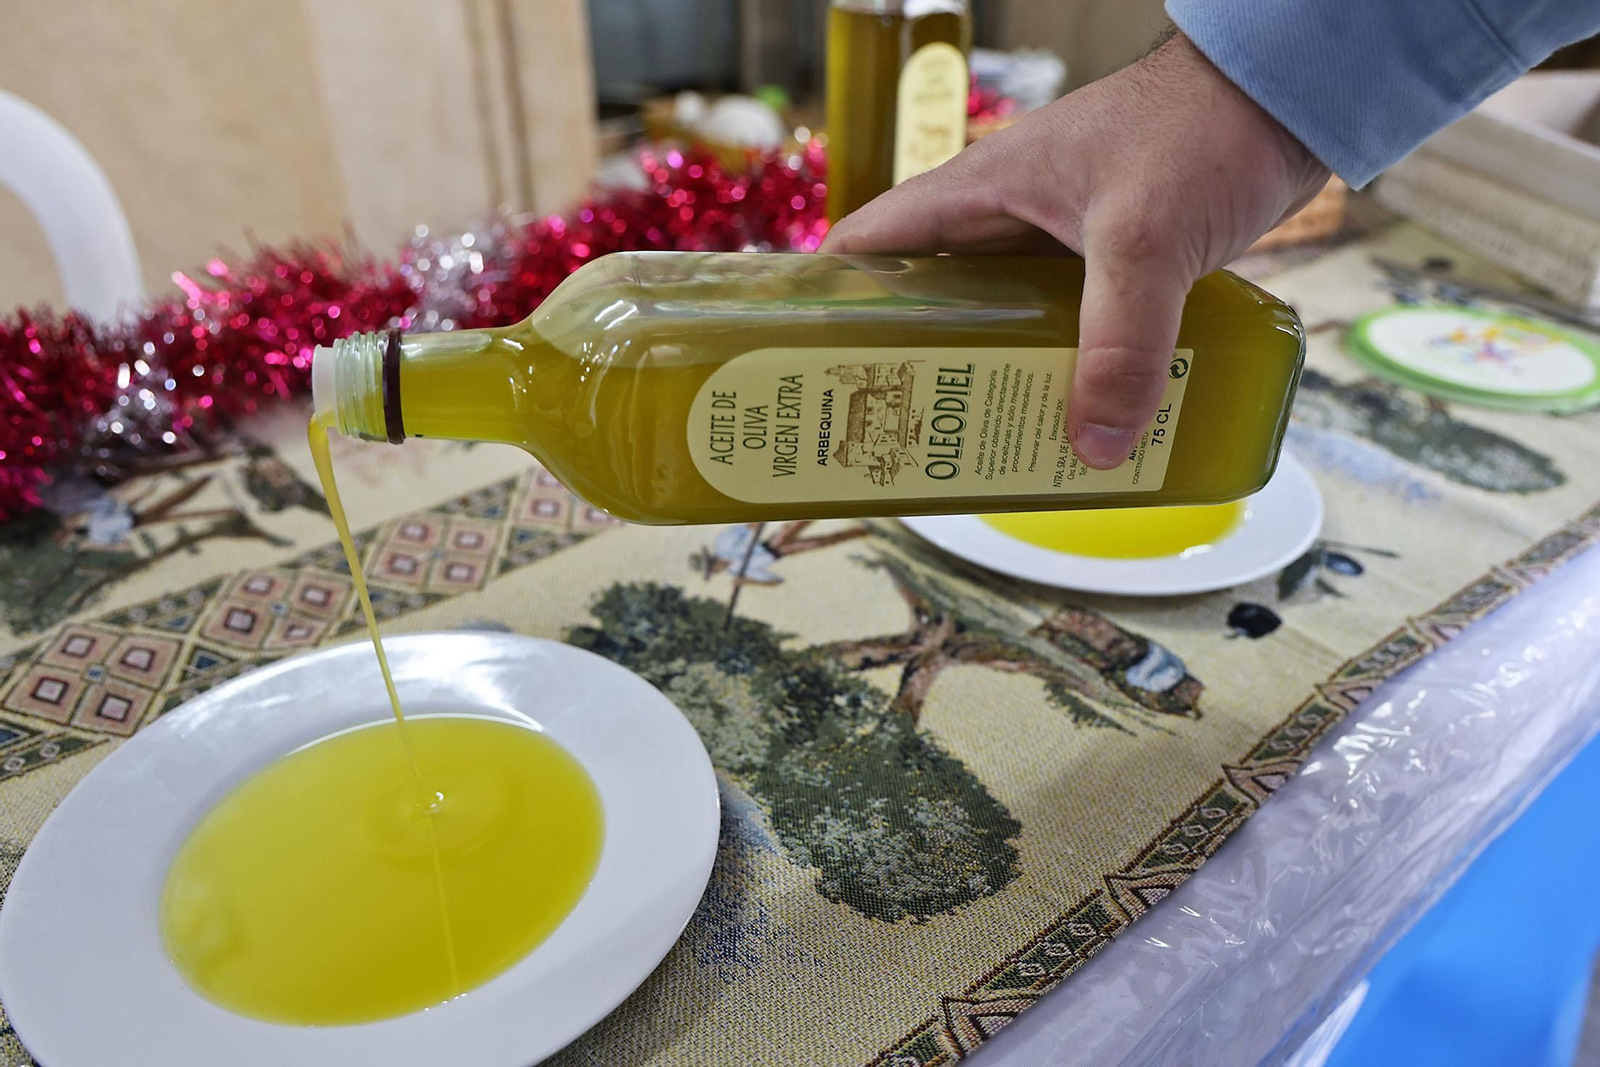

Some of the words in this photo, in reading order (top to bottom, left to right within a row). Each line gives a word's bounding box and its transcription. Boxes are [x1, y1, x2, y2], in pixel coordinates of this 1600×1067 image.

[712, 391, 736, 409] DE
[777, 375, 803, 419] EXTRA
[996, 364, 1011, 412] directamente
[1010, 369, 1022, 403] mediante
[1040, 393, 1048, 401] de
[743, 405, 768, 449] OLIVA
[818, 389, 834, 466] ARBEQUINA
[925, 363, 975, 480] OLEODIEL
[983, 408, 991, 418] de
[1011, 416, 1026, 472] procedimientos
[1020, 372, 1033, 414] mecánicos.
[1036, 410, 1045, 426] calor
[1049, 412, 1060, 441] Envasado
[1157, 404, 1171, 424] CL
[710, 415, 735, 465] ACEITE
[980, 420, 989, 438] Oliva
[991, 415, 1002, 448] obtenido
[1034, 428, 1042, 439] del
[1151, 429, 1165, 446] 75
[772, 425, 799, 477] VIRGEN
[978, 441, 986, 450] de
[1001, 430, 1012, 464] aceitunas
[1028, 440, 1040, 472] Preservar
[1060, 445, 1068, 453] DE
[975, 452, 984, 475] Aceite
[985, 450, 997, 480] Superior
[998, 466, 1006, 475] de
[1132, 450, 1145, 484] CONTENIDO
